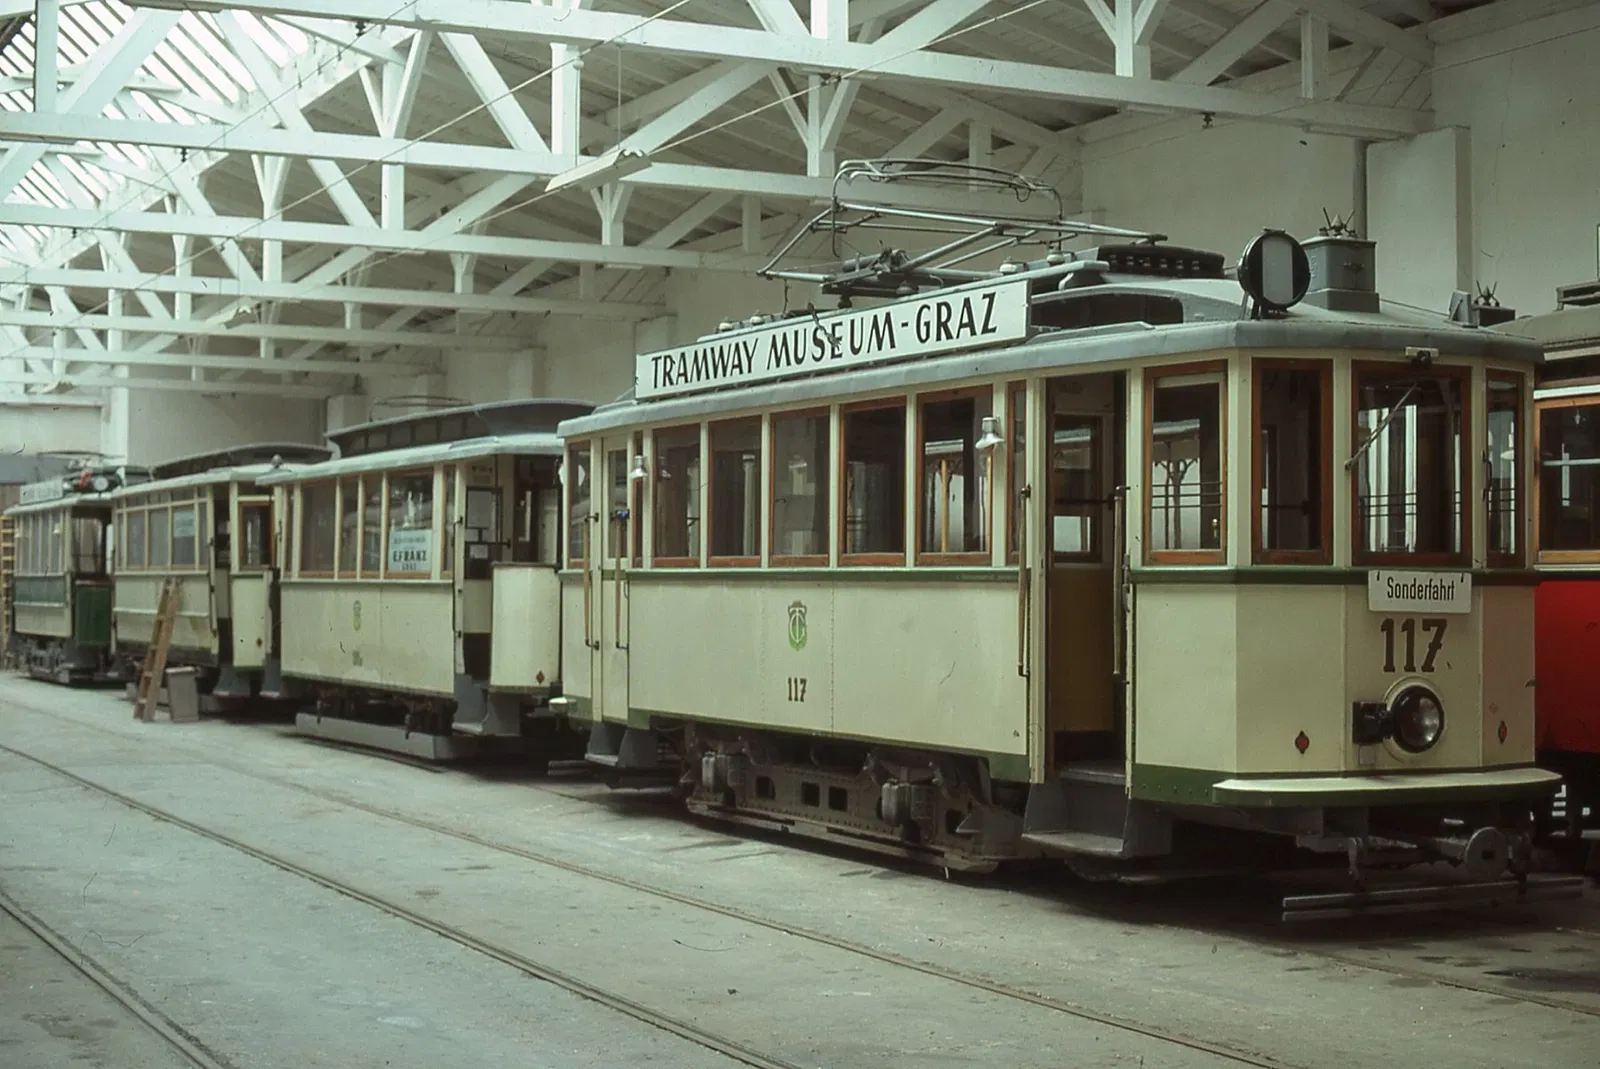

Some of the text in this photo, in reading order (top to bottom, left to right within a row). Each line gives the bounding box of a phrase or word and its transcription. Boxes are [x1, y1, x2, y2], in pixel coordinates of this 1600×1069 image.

[651, 338, 758, 389] TRAMWAY
[1387, 577, 1455, 601] Sonderfahrt
[1381, 618, 1448, 673] 117
[788, 677, 807, 702] 117
